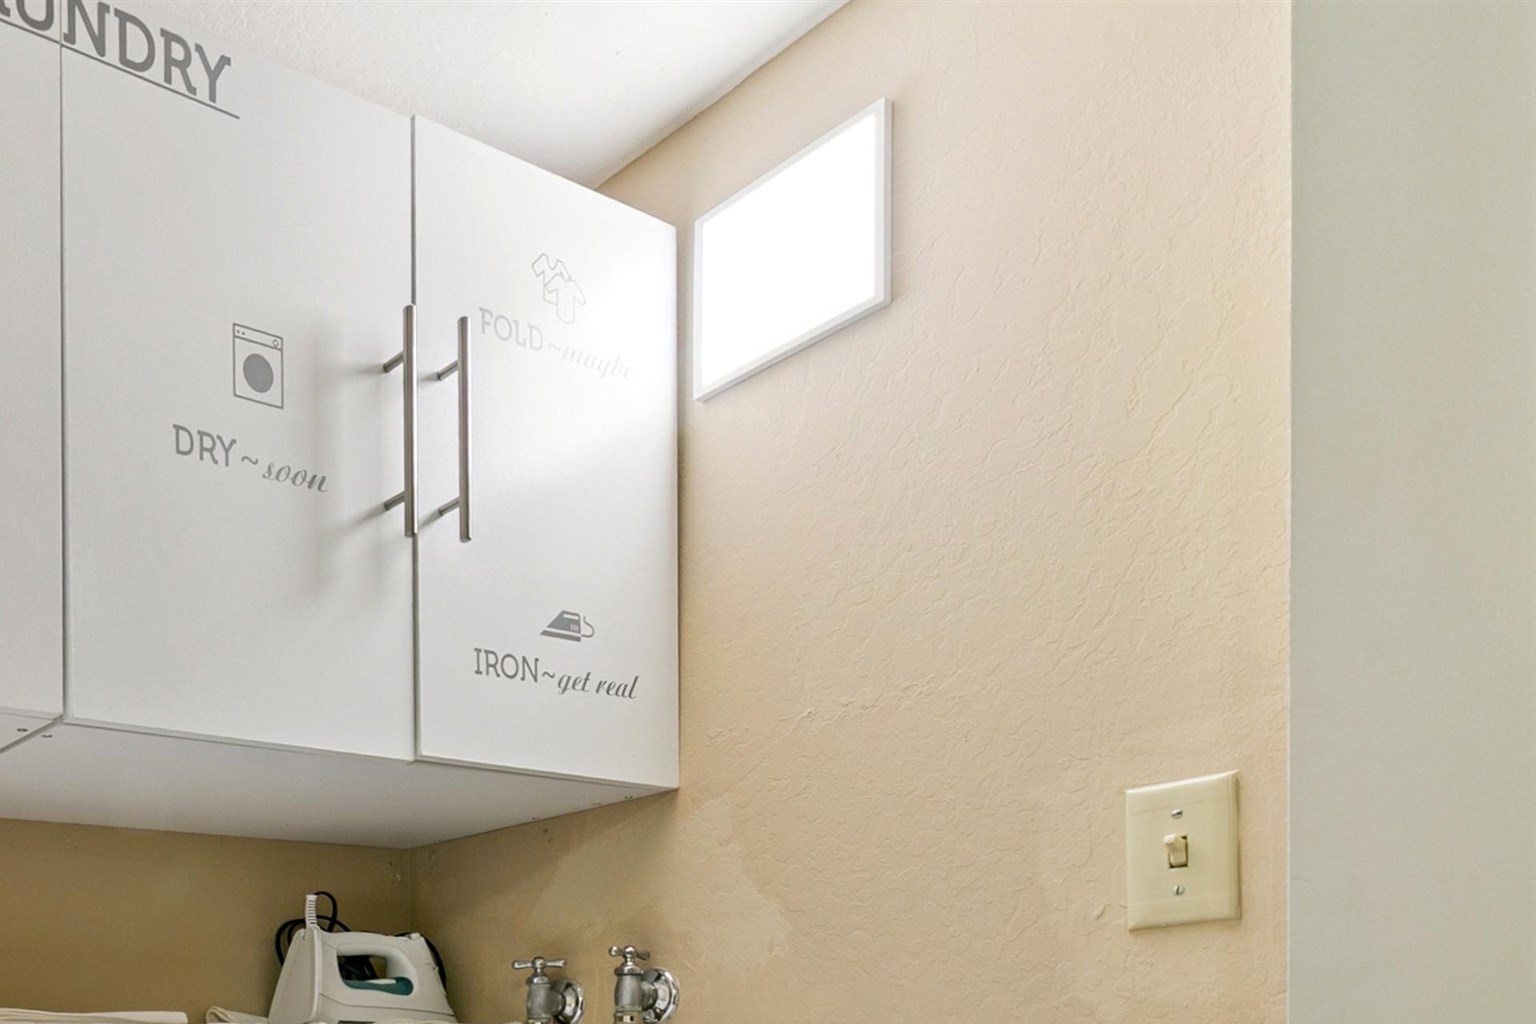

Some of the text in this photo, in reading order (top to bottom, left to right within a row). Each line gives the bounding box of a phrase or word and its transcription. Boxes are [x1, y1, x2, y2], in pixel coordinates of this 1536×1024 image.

[478, 307, 543, 351] FOLD
[172, 424, 237, 467] DRY
[262, 462, 328, 493] soon
[474, 648, 539, 683] IRON
[557, 671, 593, 695] get
[595, 675, 640, 699] real
